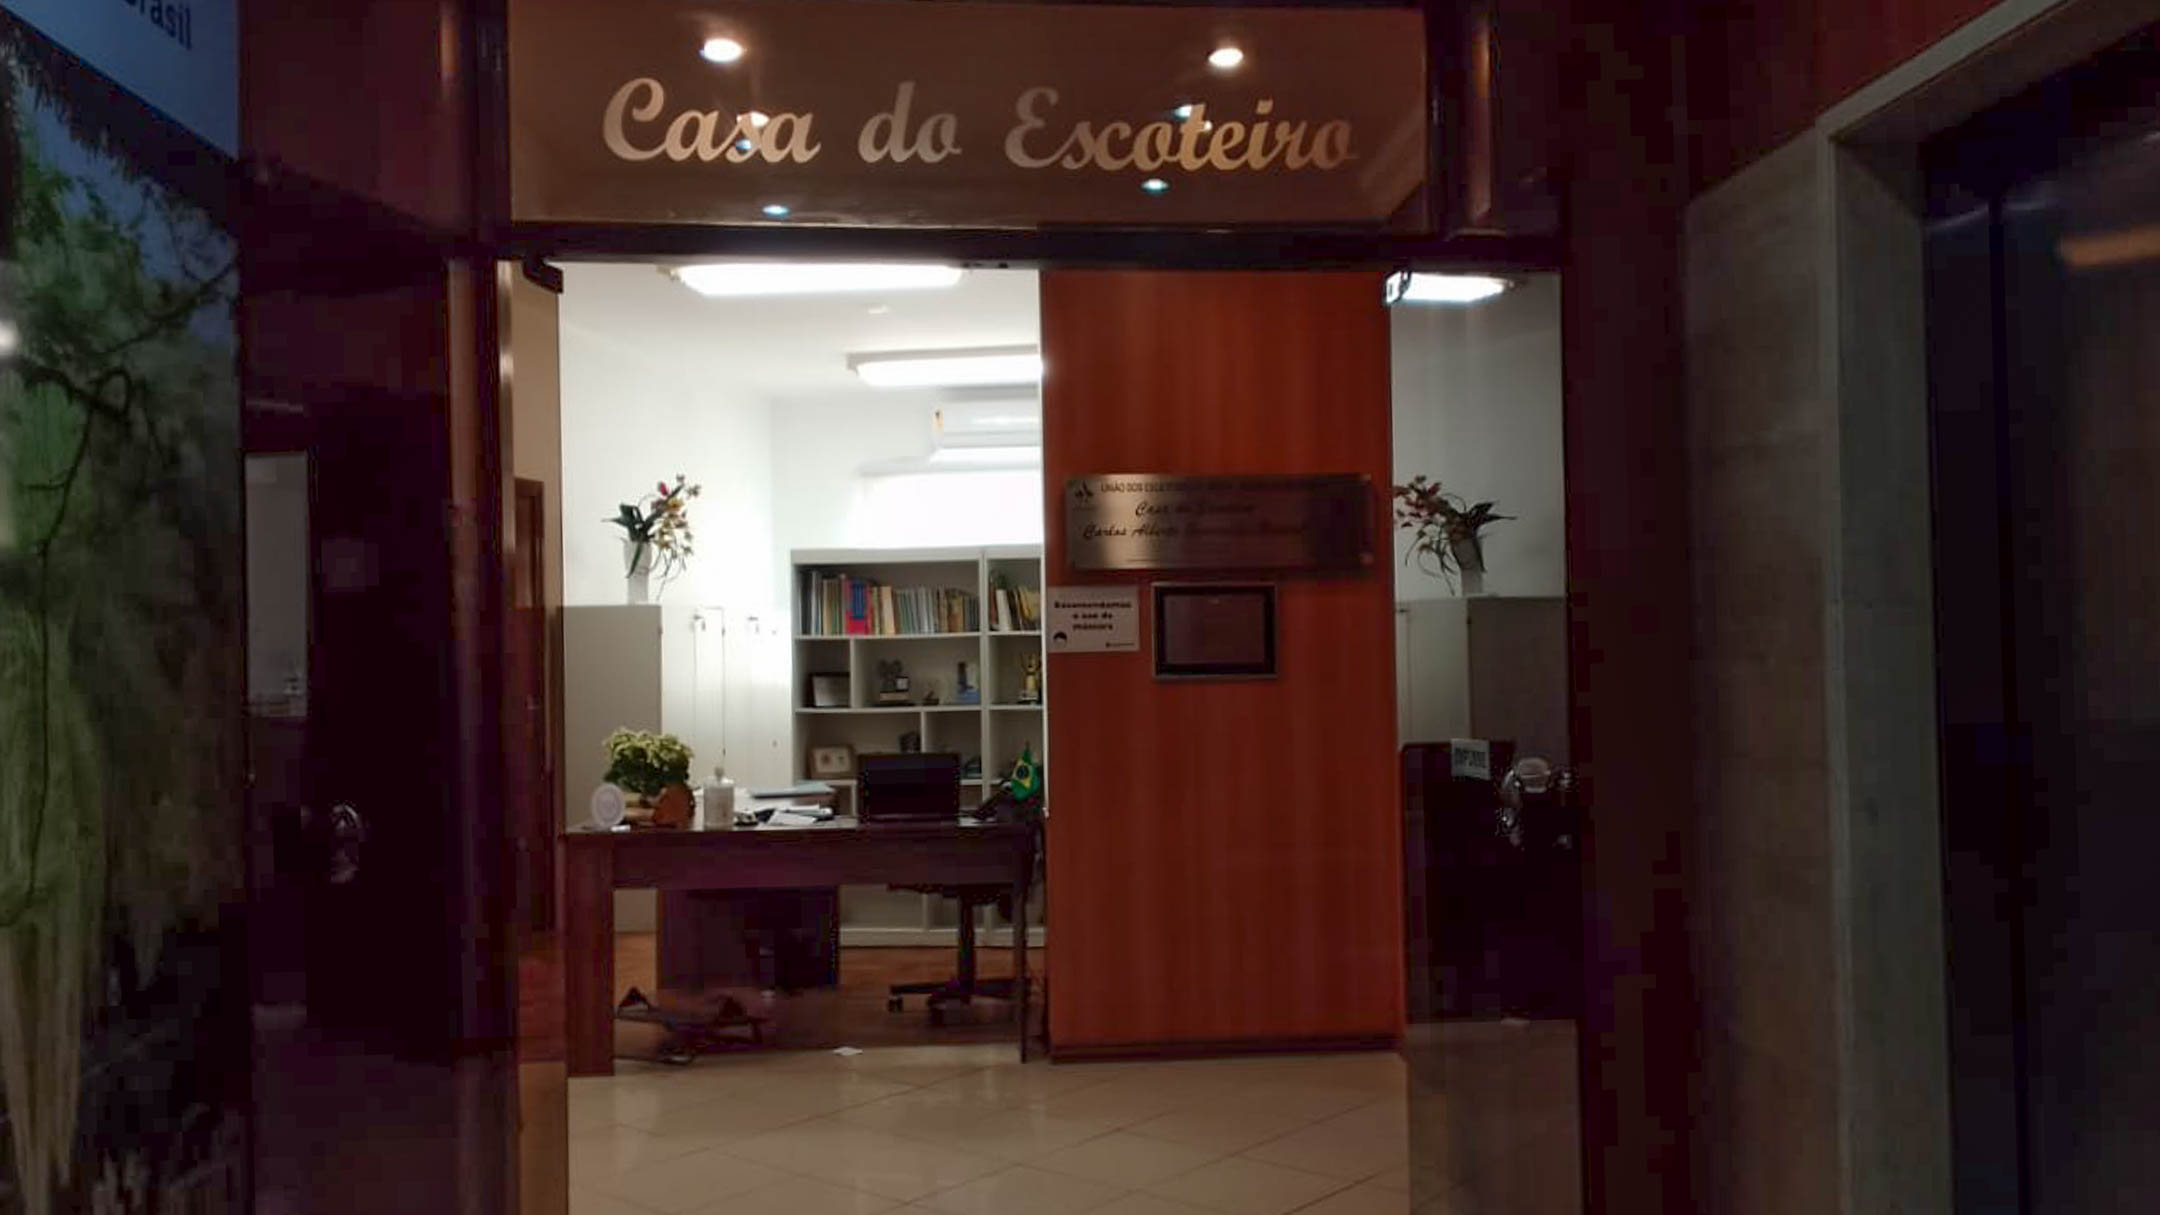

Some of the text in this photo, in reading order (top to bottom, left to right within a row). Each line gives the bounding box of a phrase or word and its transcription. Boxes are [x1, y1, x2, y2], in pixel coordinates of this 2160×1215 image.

[126, 0, 193, 51] rasil
[603, 77, 1359, 170] Casa do Escoteiro
